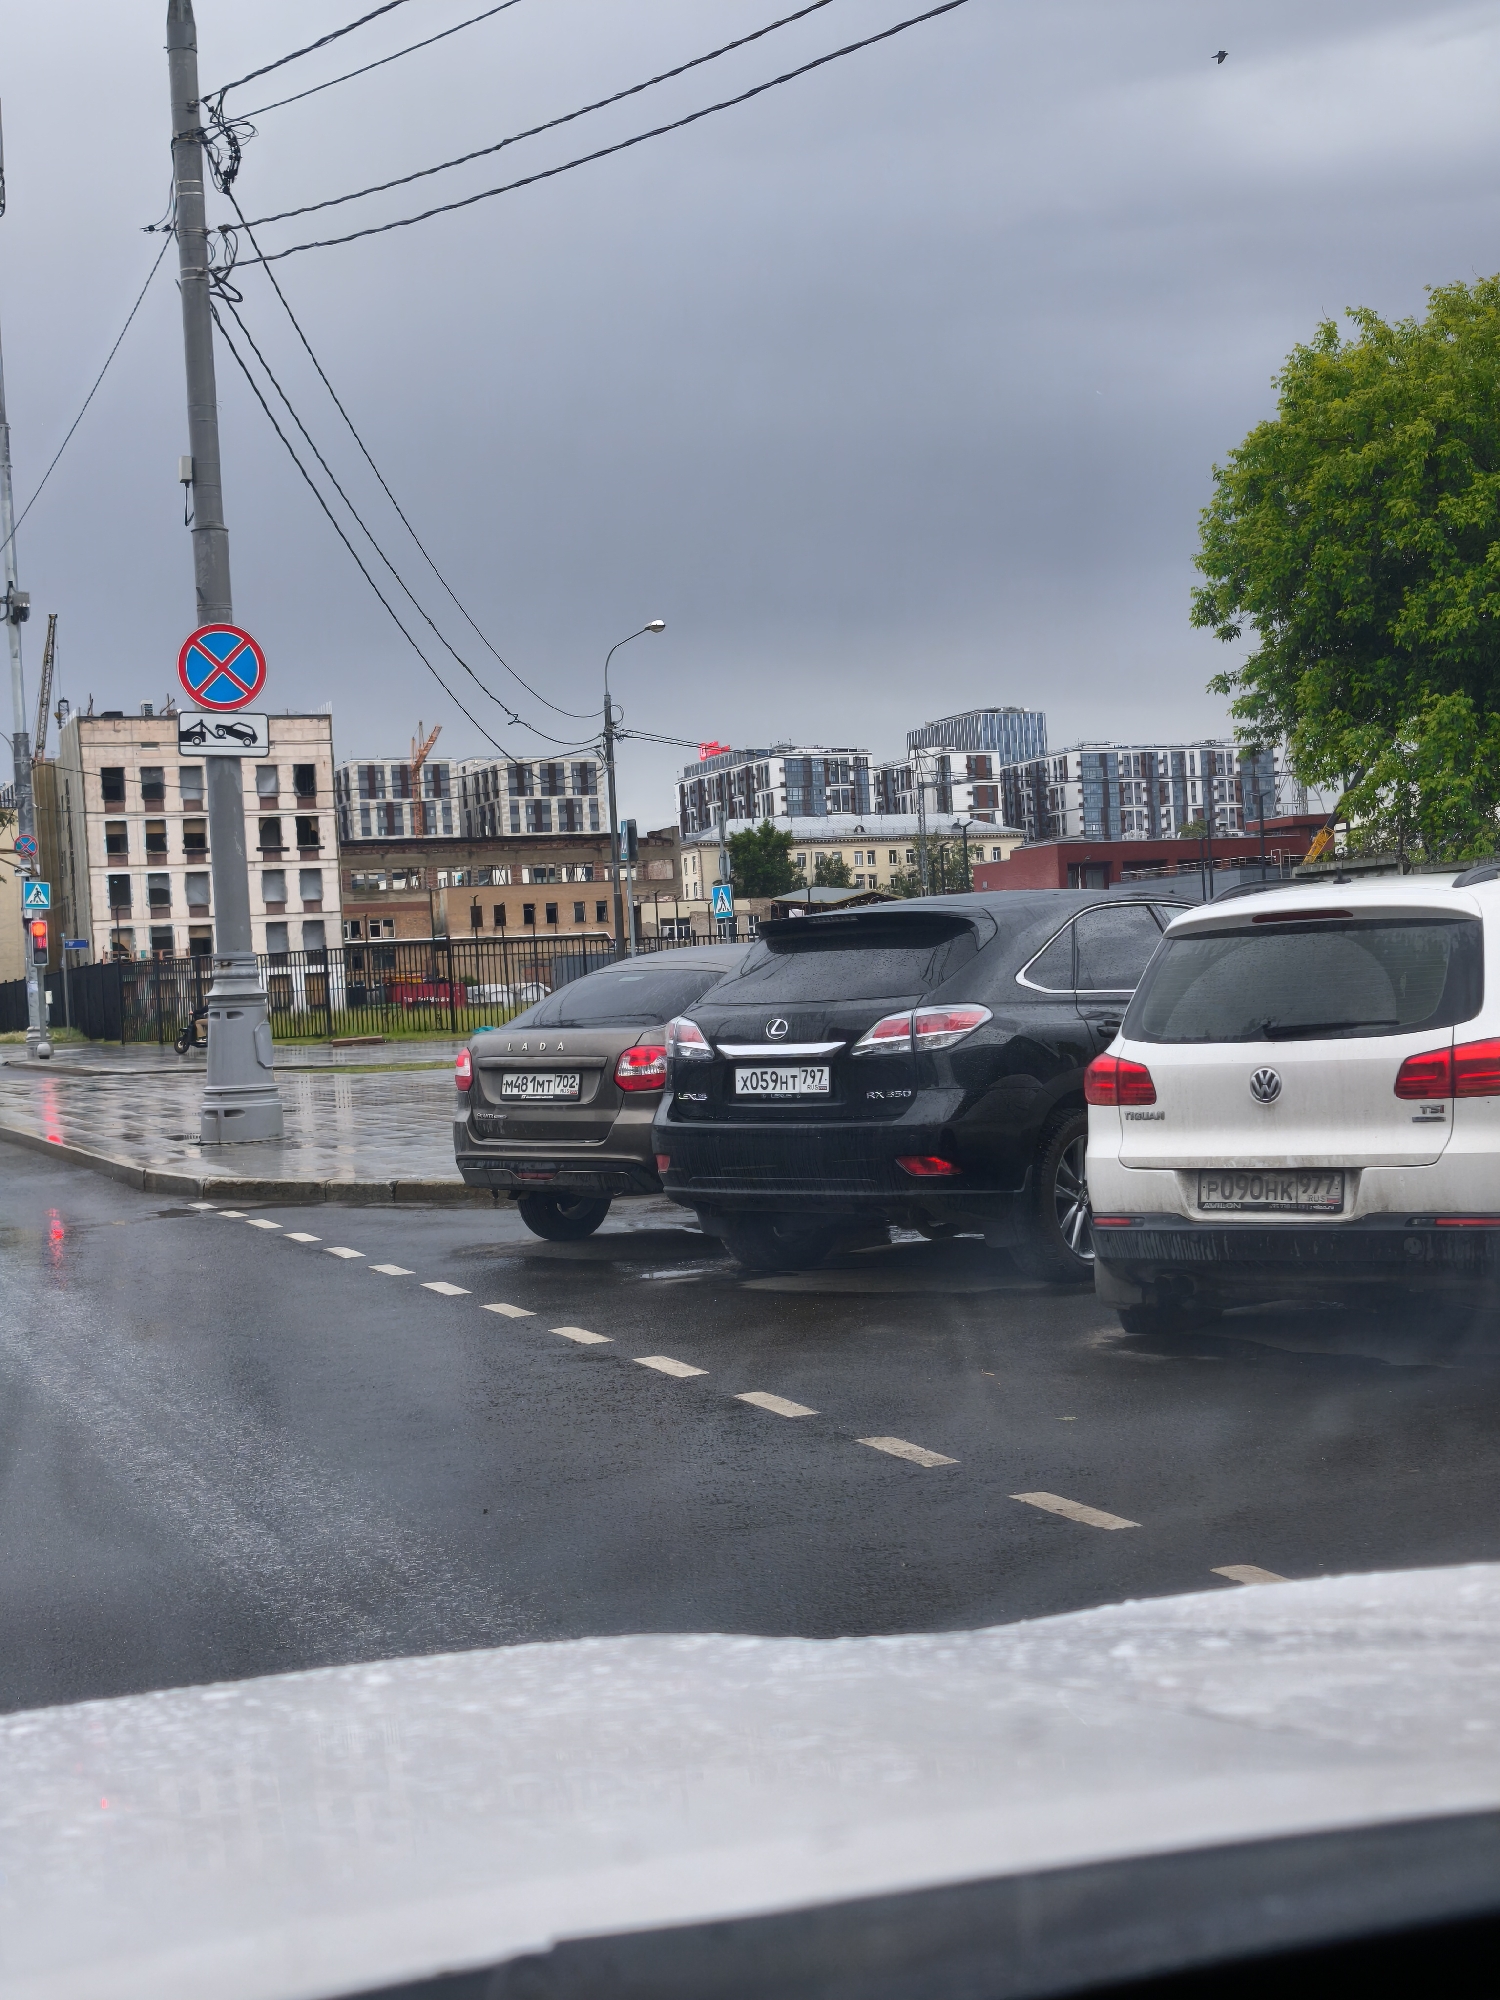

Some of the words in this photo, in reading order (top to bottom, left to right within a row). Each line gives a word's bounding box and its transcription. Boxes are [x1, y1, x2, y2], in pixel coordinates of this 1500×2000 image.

[507, 1042, 564, 1051] LADA
[556, 1075, 576, 1088] 702
[801, 1069, 824, 1084] 797
[1300, 1174, 1334, 1194] 977
